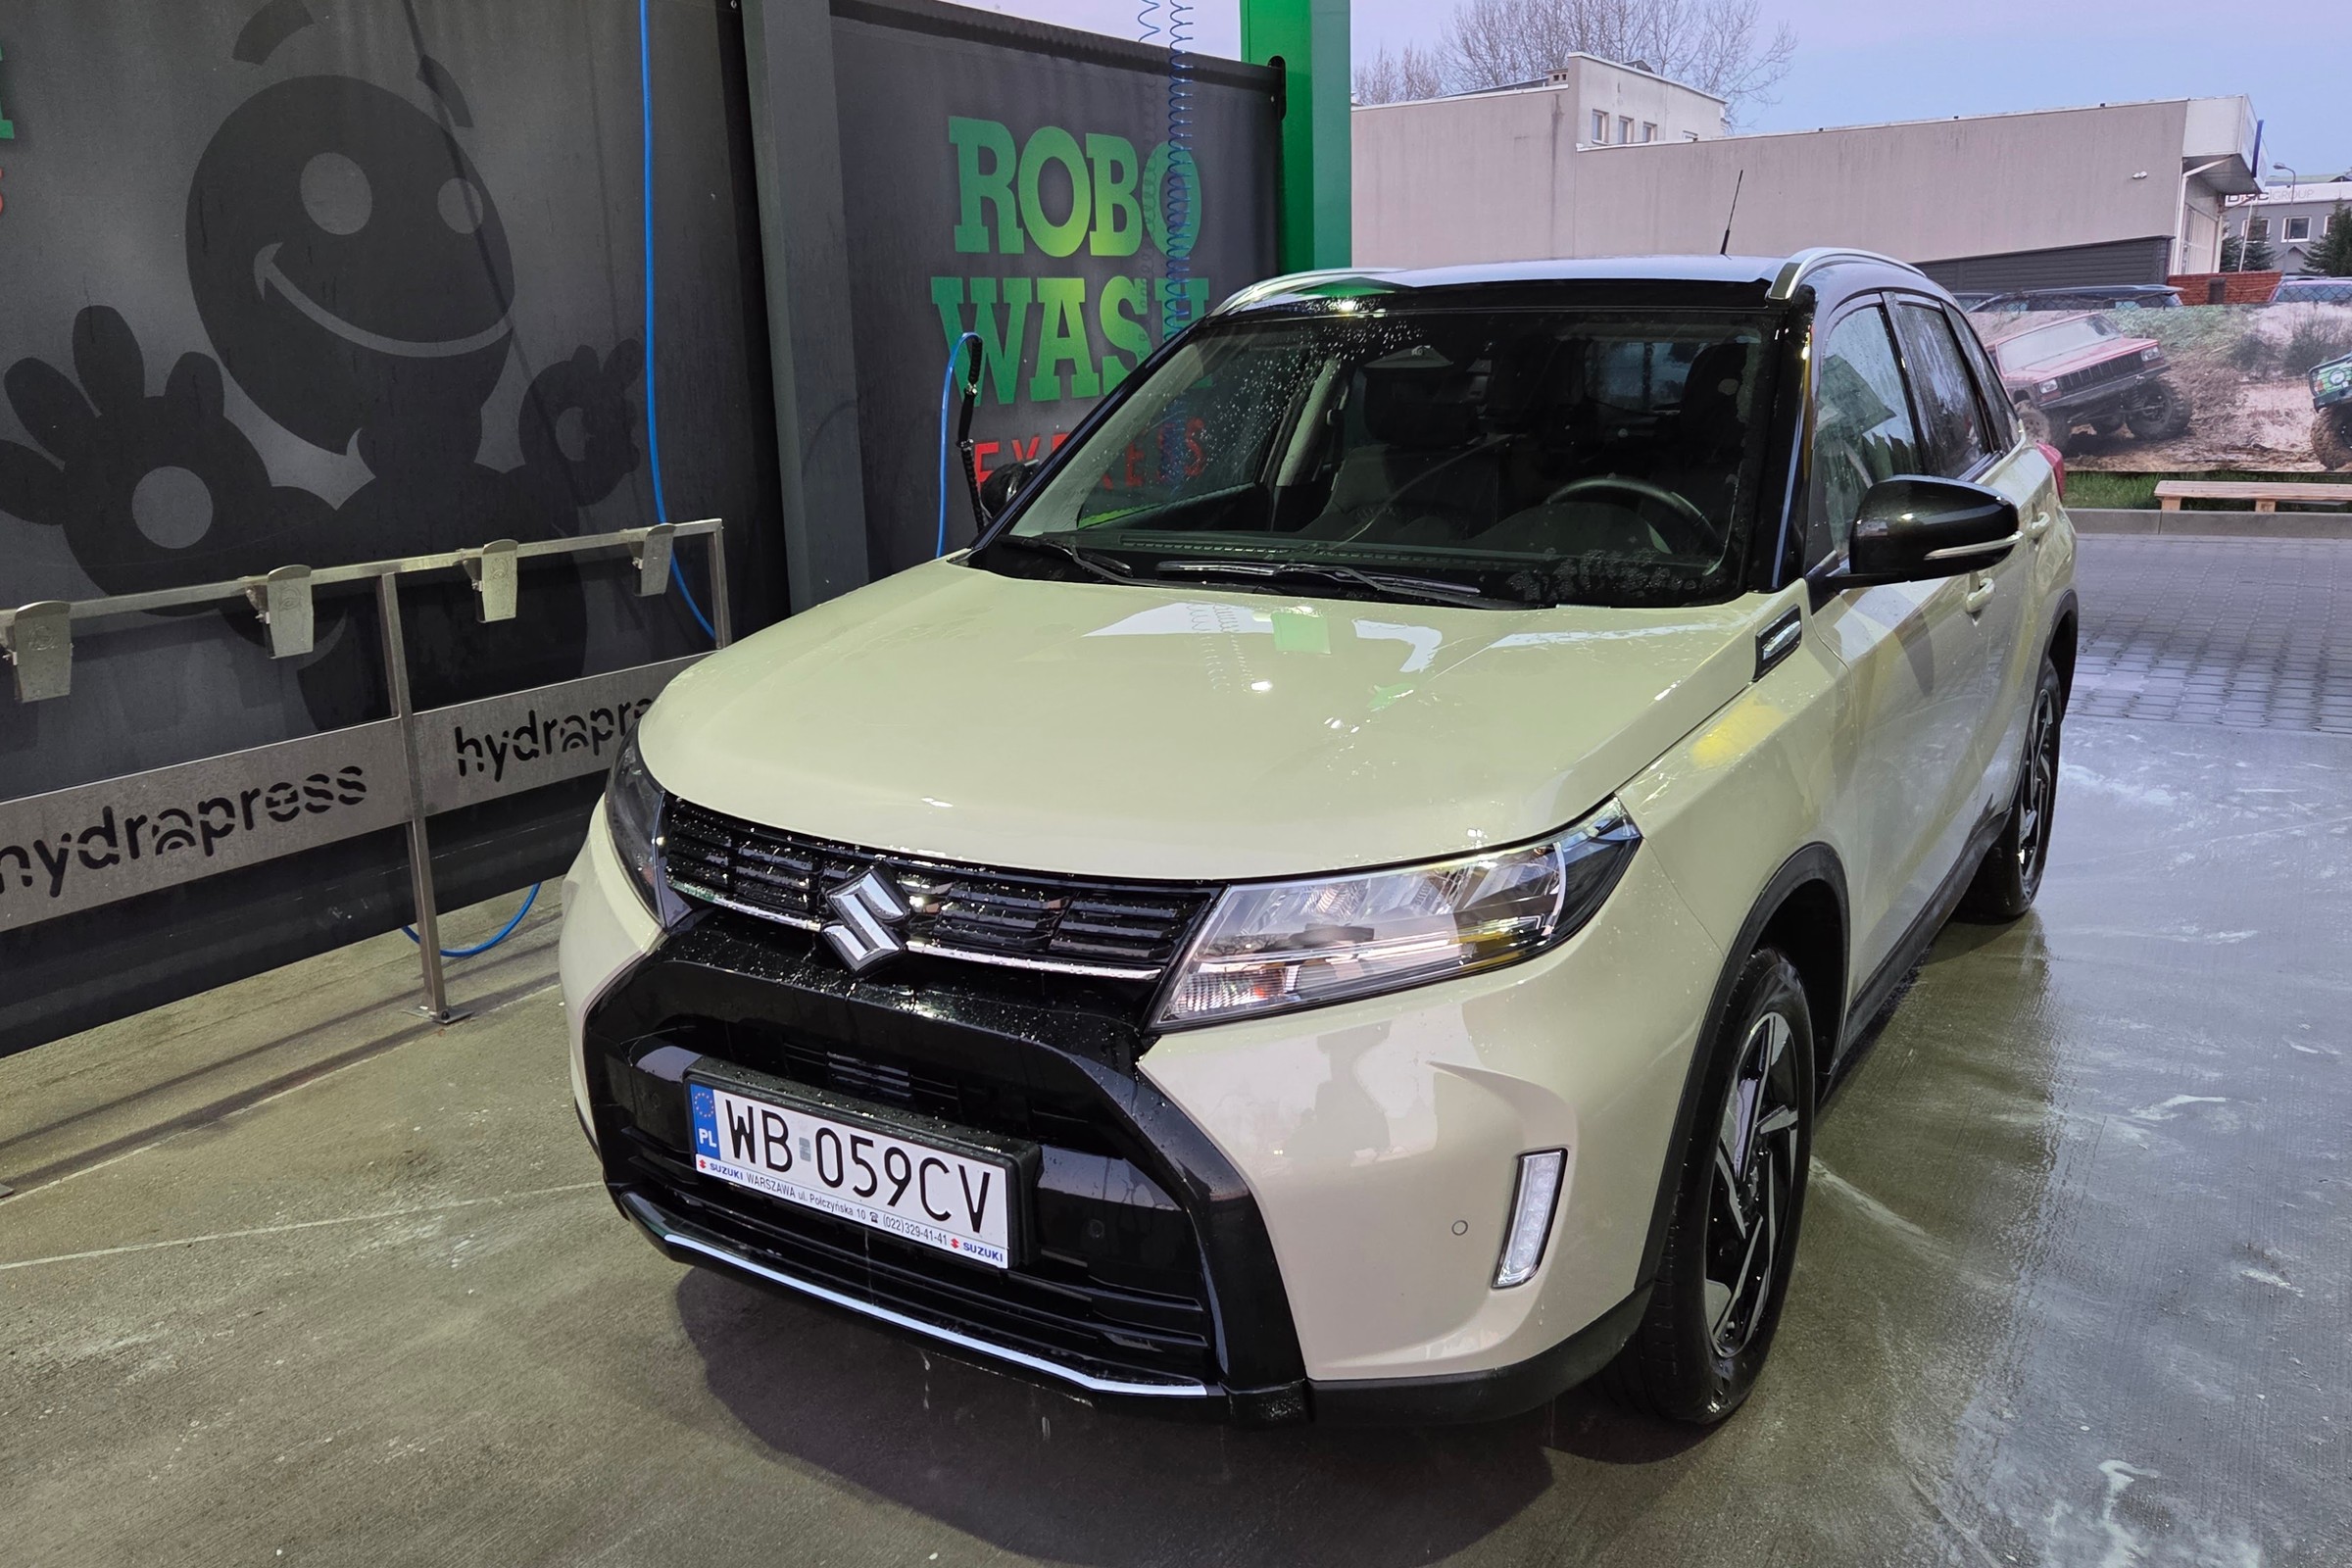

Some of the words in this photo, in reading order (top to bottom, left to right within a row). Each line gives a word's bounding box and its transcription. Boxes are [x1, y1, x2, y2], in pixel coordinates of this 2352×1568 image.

[948, 116, 1201, 258] ROBO
[698, 1128, 717, 1149] PL
[725, 1099, 793, 1173] WB
[815, 1127, 991, 1234] 059CV
[710, 1162, 744, 1180] SUZUKI
[746, 1172, 796, 1197] WARSZAWA
[798, 1191, 808, 1201] ul.
[857, 1208, 866, 1220] 10
[962, 1242, 1004, 1262] SUZUKI
